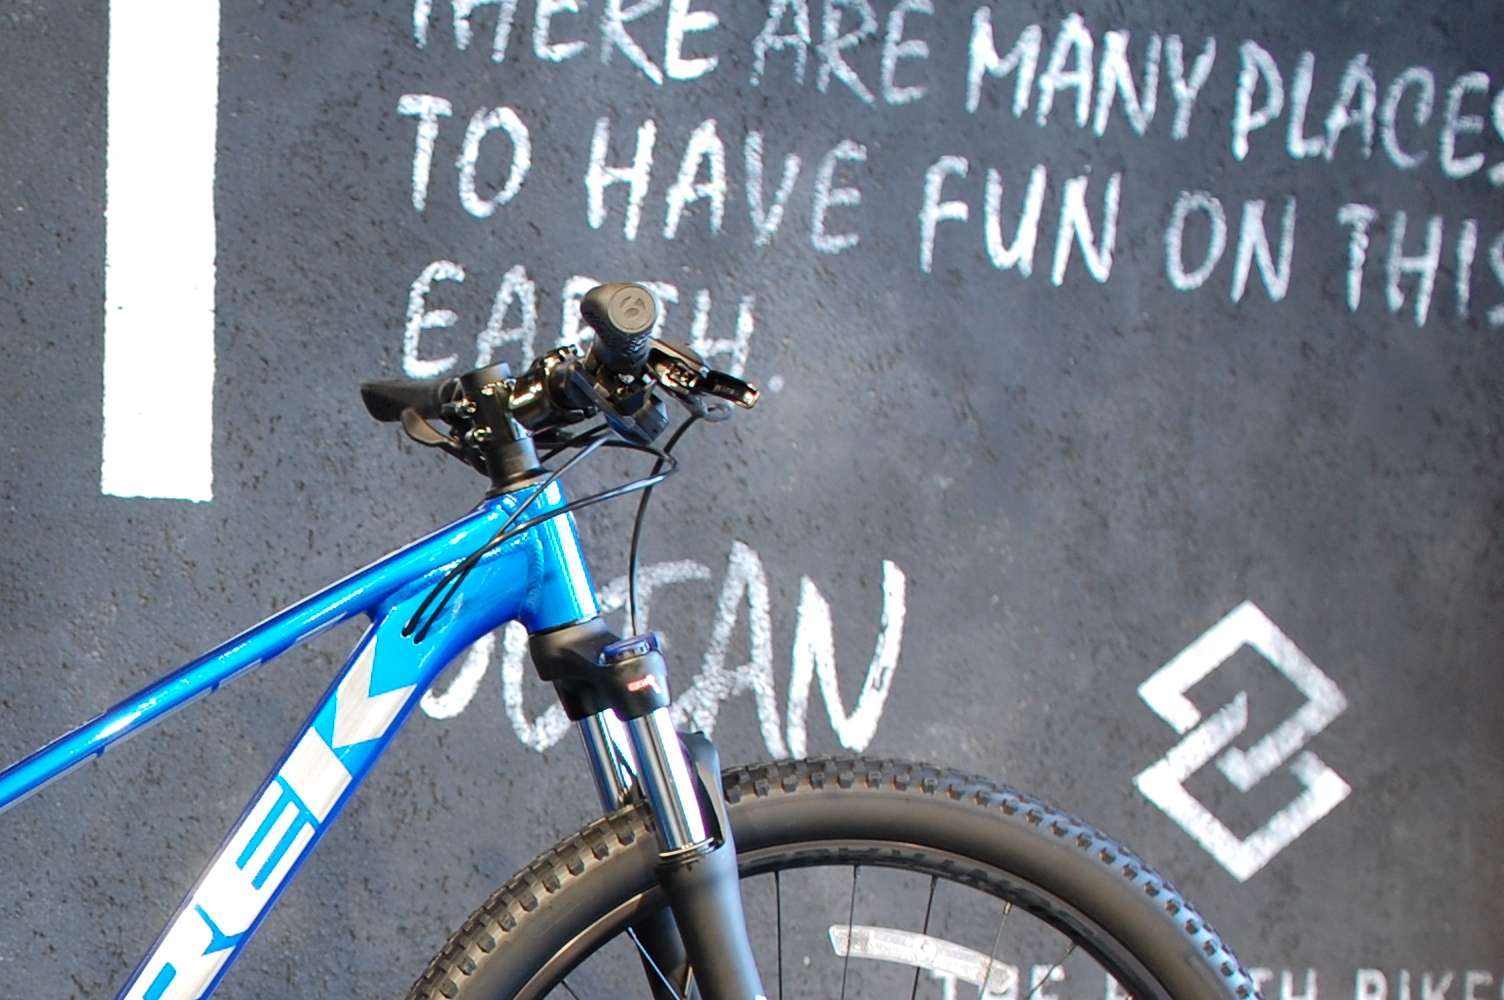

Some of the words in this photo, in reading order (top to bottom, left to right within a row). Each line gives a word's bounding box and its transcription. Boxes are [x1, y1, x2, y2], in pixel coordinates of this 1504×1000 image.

[749, 0, 937, 107] ARE
[965, 5, 1216, 141] MANY
[1232, 38, 1504, 186] PLACE
[397, 93, 532, 218] TO
[585, 115, 867, 254] HAVE
[919, 155, 1122, 286] FUN
[1165, 190, 1296, 302] ON
[1336, 203, 1504, 328] THI
